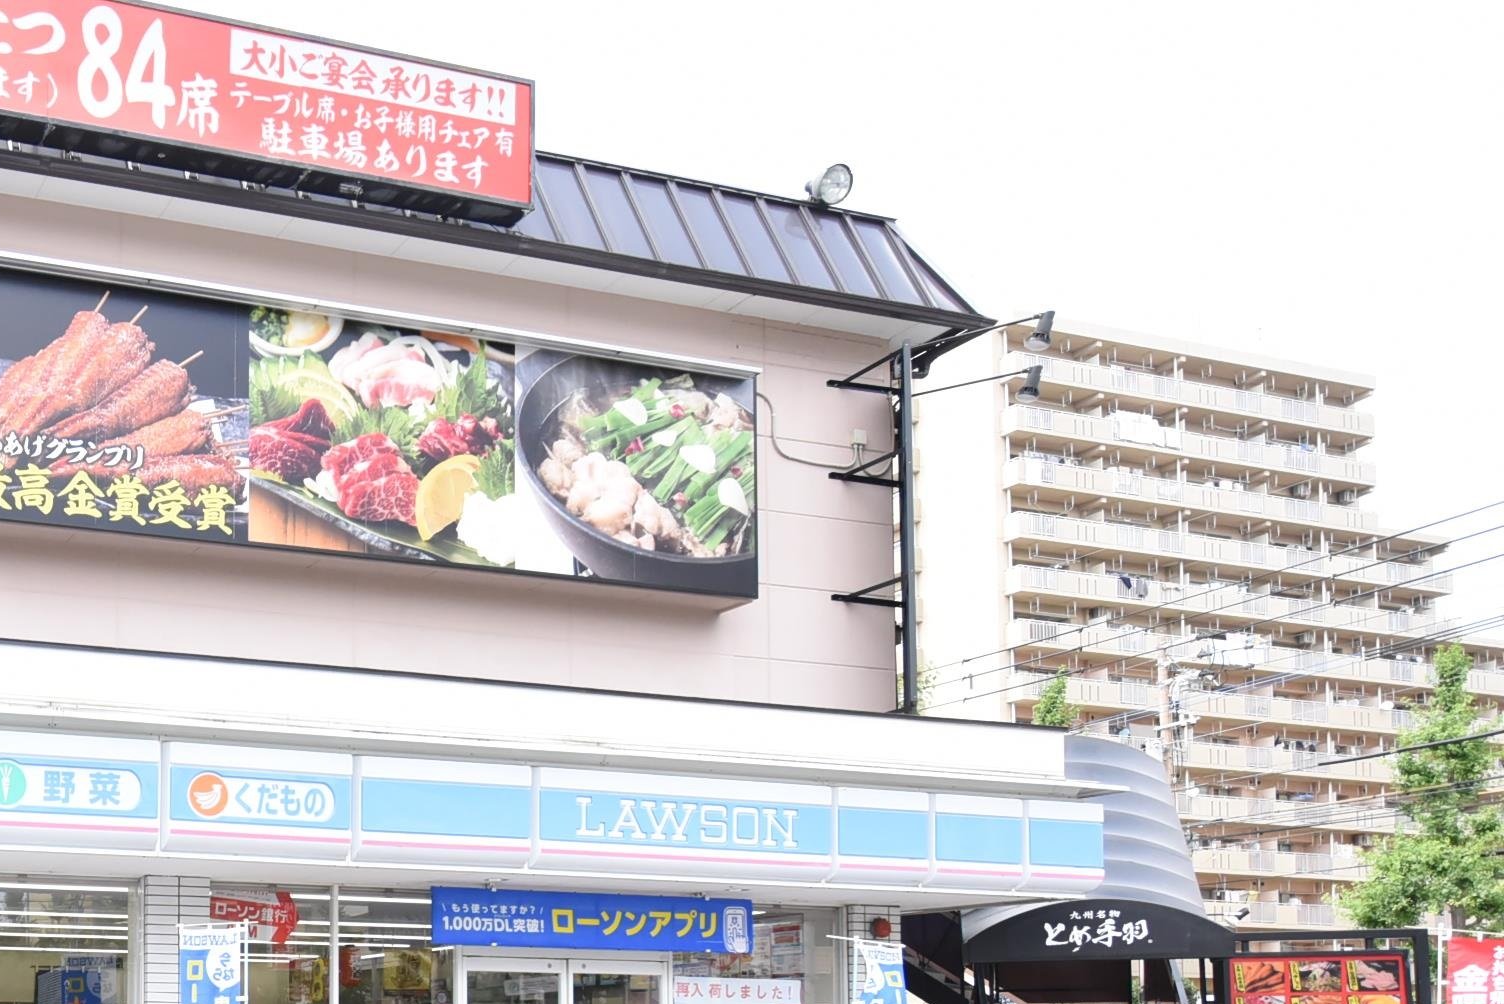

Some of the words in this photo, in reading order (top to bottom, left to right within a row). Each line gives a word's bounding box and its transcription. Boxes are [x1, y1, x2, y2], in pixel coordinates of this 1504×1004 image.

[259, 116, 489, 189] 駐車場あります
[43, 770, 122, 807] 野菜
[234, 783, 327, 818] くだもの
[575, 797, 799, 850] LAWSON
[214, 901, 289, 924] ローソン銀行
[551, 908, 718, 939] ローソンアプリ
[1069, 909, 1121, 920] 九州名物
[676, 982, 793, 1000] 再入荷しました!
